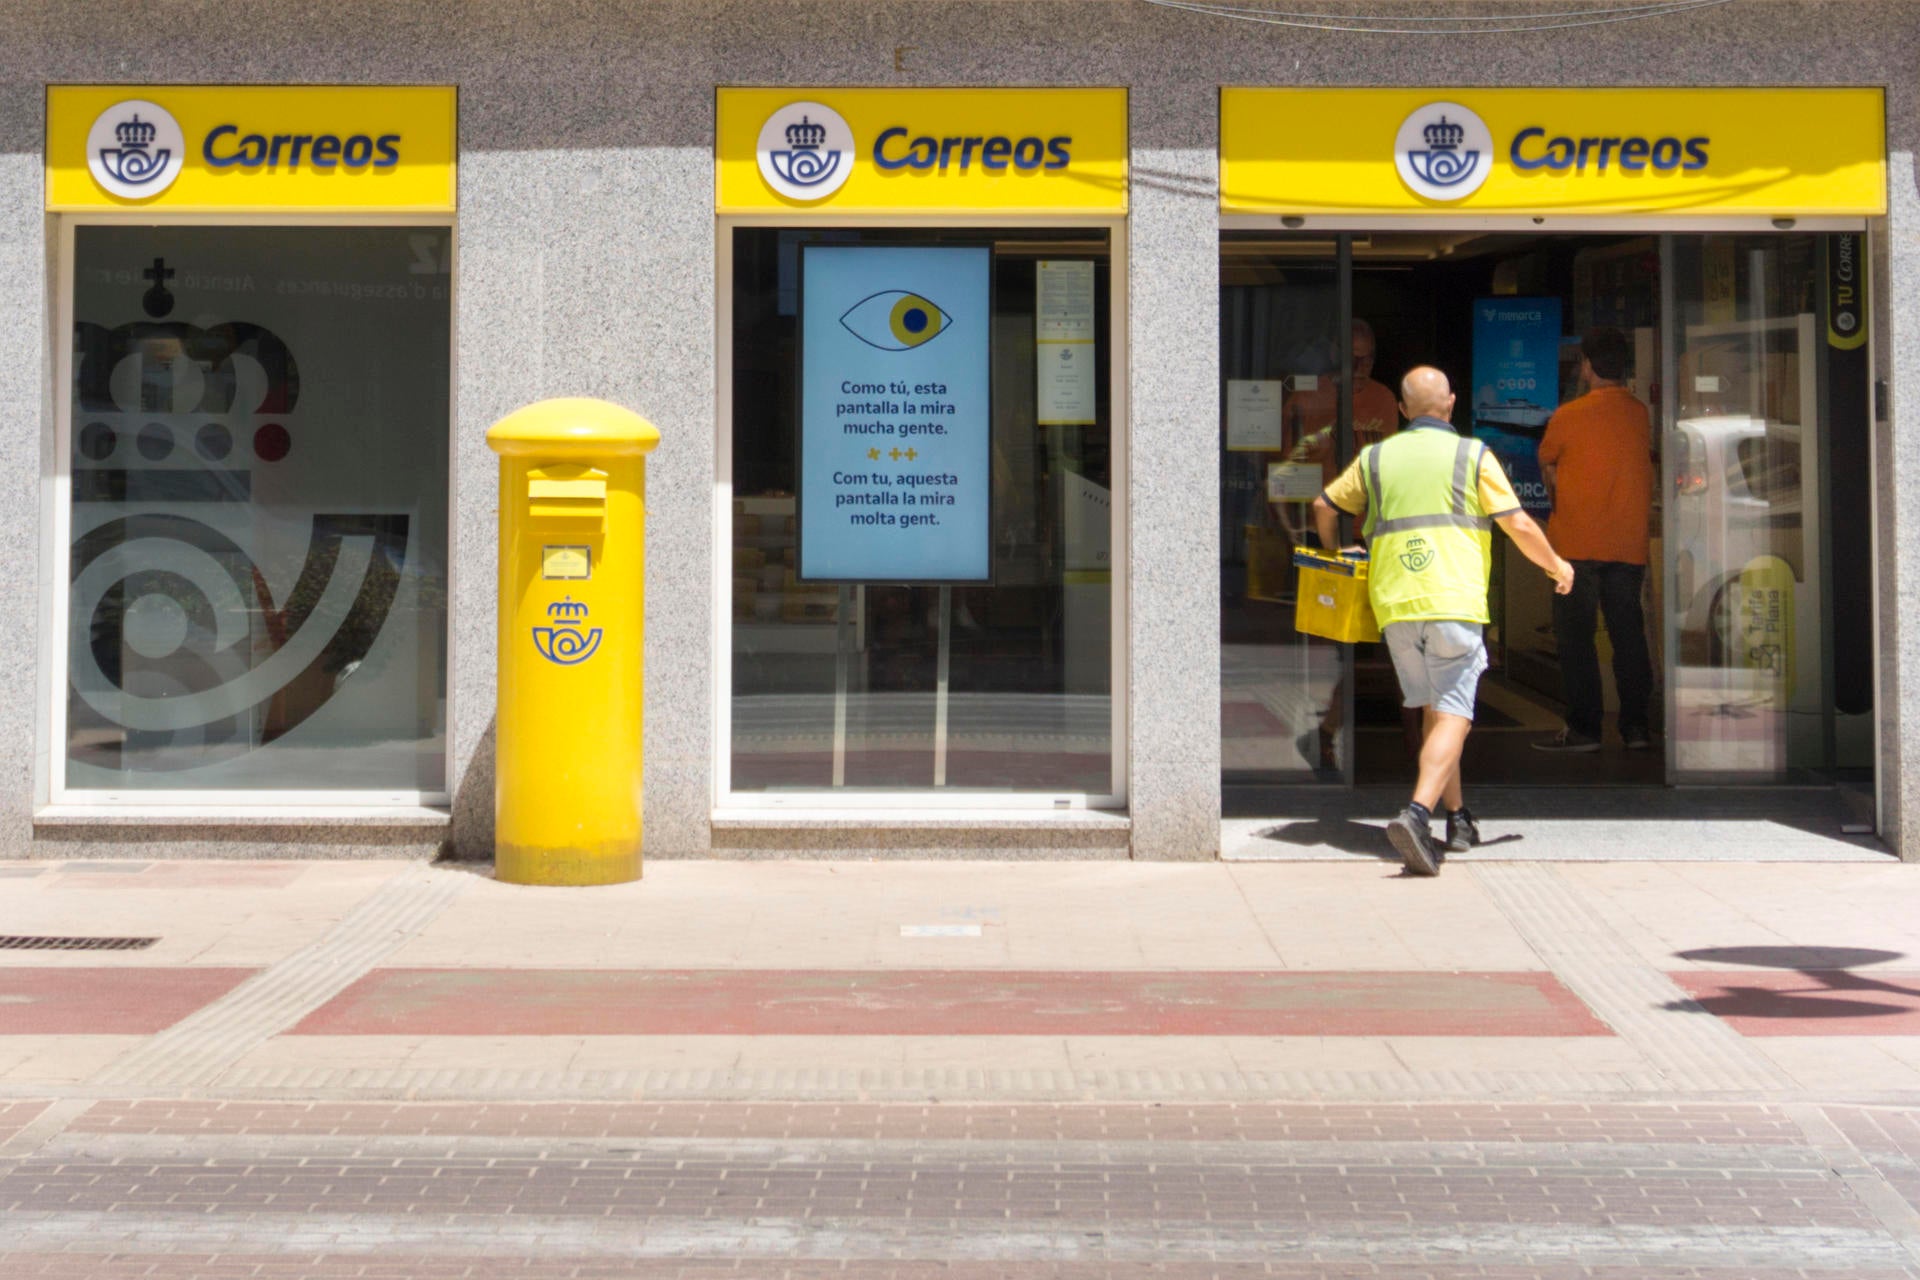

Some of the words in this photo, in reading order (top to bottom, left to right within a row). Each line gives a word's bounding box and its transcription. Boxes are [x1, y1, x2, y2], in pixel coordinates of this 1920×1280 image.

[204, 126, 400, 166] Correos
[874, 128, 1071, 169] Correos
[1511, 128, 1708, 169] Correos
[1838, 285, 1853, 305] TU
[1497, 310, 1542, 321] menorca
[841, 381, 886, 395] Como
[889, 379, 911, 398] tú,
[914, 382, 948, 395] esta
[836, 400, 899, 417] pantalla
[902, 400, 917, 415] la
[919, 400, 956, 415] mira
[843, 420, 894, 435] mucha
[897, 422, 948, 438] gente.
[833, 472, 868, 485] Com
[871, 473, 893, 488] tu,
[896, 473, 959, 488] aquesta
[1512, 481, 1548, 497] ORCA
[836, 491, 899, 508] pantalla
[902, 491, 917, 505] la
[919, 491, 956, 505] mira
[849, 511, 896, 525] molta
[899, 513, 941, 528] gent.
[1748, 589, 1763, 634] Tarifa
[1766, 589, 1780, 633] Plana
